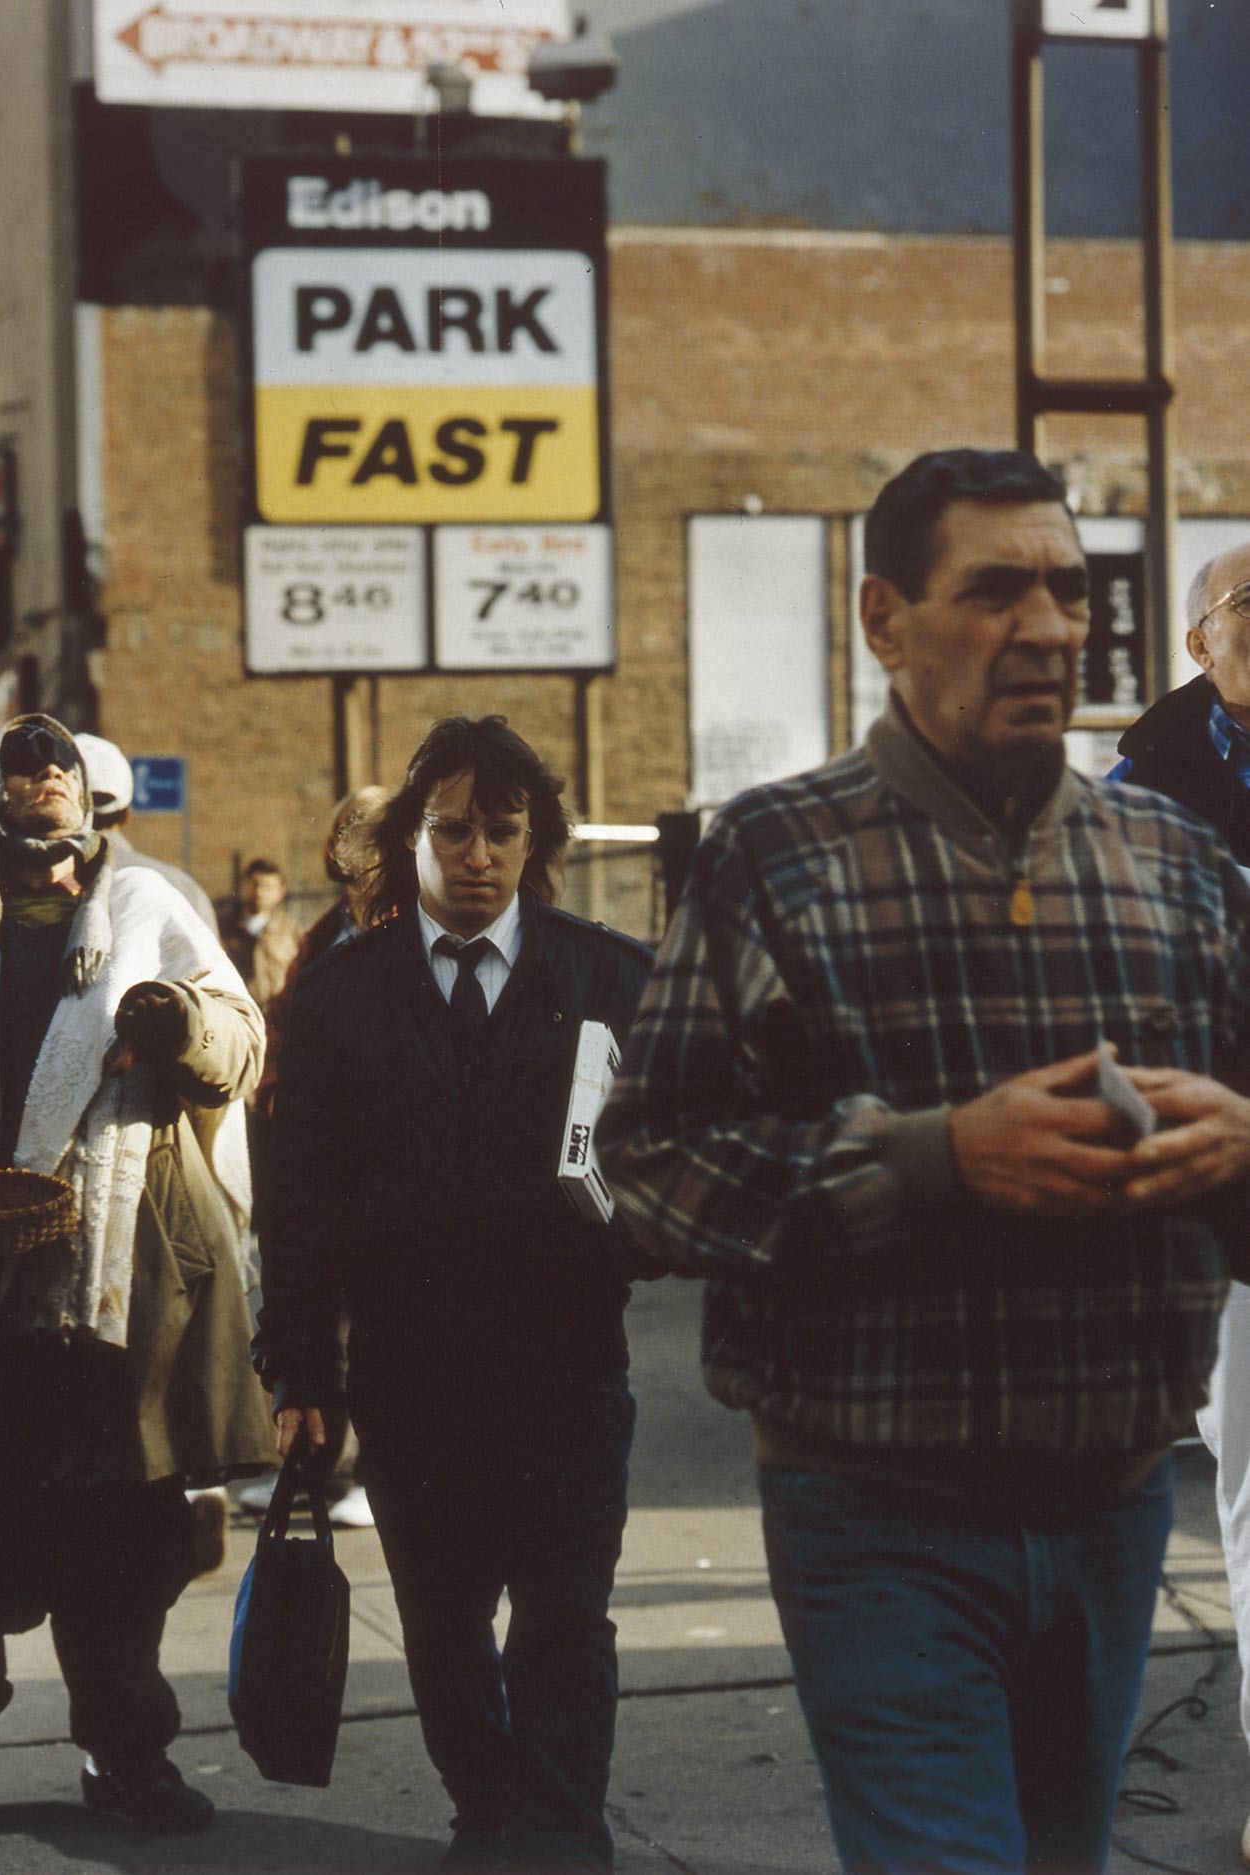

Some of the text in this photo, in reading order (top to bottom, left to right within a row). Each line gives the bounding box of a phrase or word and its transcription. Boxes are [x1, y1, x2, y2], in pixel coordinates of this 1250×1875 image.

[287, 177, 490, 230] Edison
[296, 285, 561, 352] PARK
[296, 417, 559, 485] FAST
